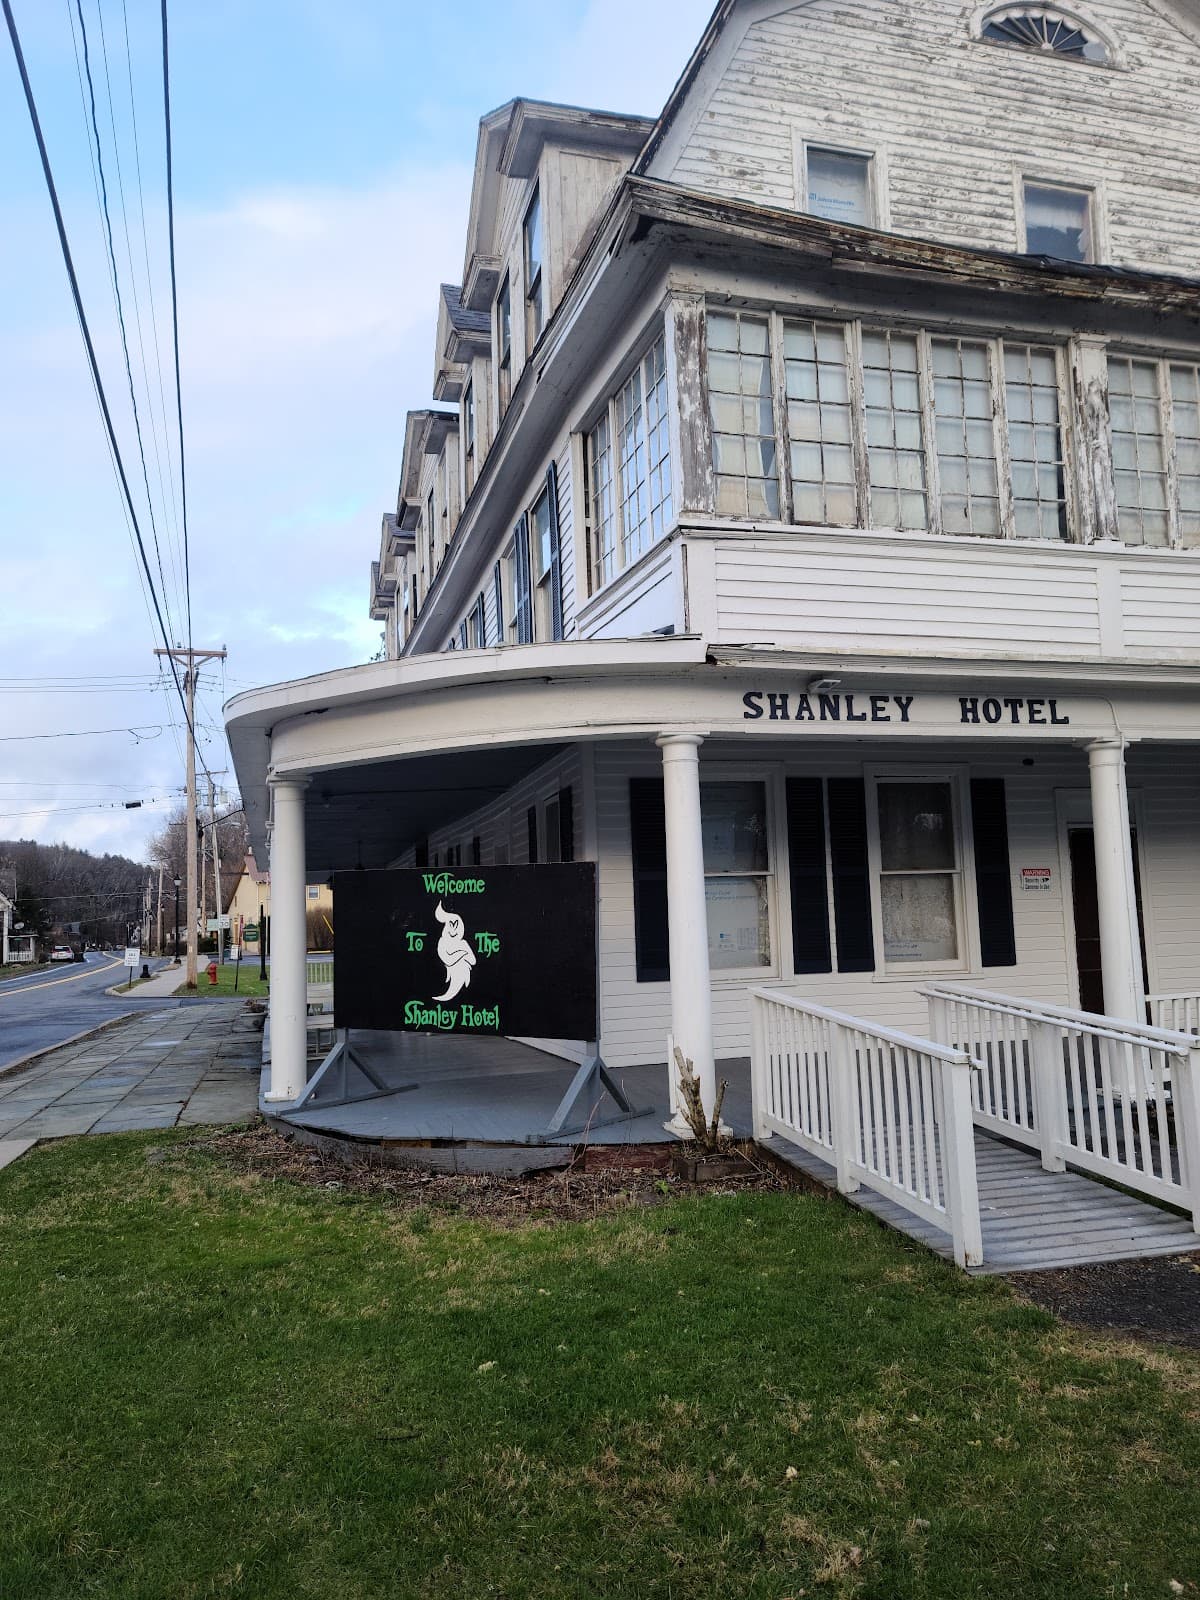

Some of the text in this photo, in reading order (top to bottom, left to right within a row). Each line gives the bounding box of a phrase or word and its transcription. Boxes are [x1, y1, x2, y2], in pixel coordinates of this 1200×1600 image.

[743, 691, 1070, 725] SHANLEY HOTEL
[422, 872, 486, 896] Welcome
[405, 931, 501, 958] To The
[404, 1000, 500, 1031] Shanley Hotel
